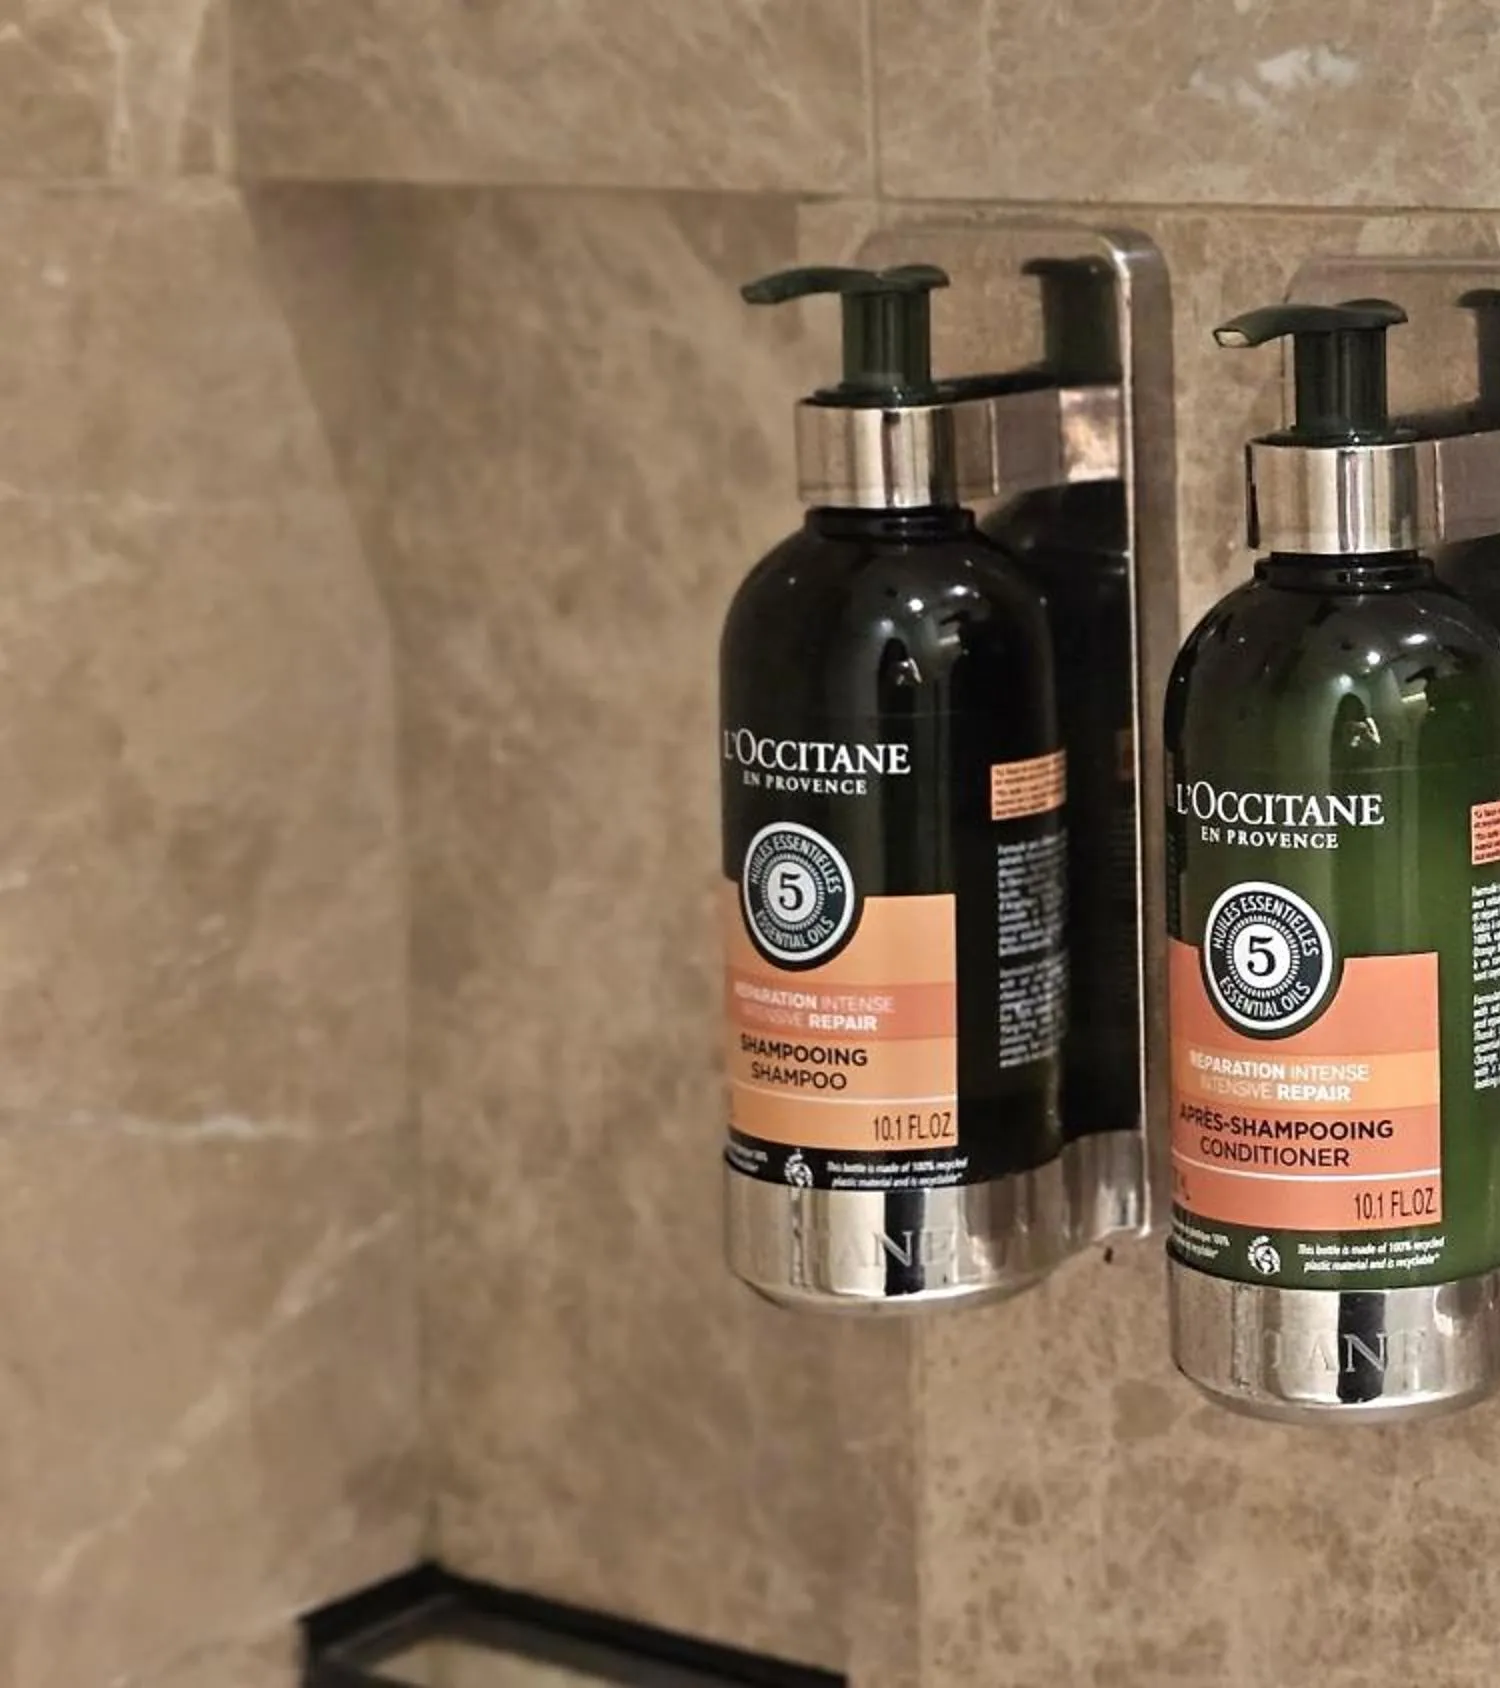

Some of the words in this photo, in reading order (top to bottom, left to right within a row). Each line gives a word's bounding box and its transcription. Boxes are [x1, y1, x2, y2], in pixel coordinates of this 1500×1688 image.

[725, 728, 911, 775] L'OCCITANE
[743, 771, 760, 786] EN
[764, 775, 867, 795] PROVENCE
[1177, 781, 1385, 827] L'OCCITANE
[1201, 826, 1220, 842] EN
[1227, 831, 1339, 849] PROVENCE
[779, 872, 803, 911] 5
[807, 916, 835, 943] OILS
[1212, 902, 1240, 950] HUILES
[1240, 896, 1319, 957] ESSENTIELLES
[1247, 935, 1276, 977] 5
[821, 995, 896, 1013] INTENSE
[1220, 976, 1282, 1017] ESSENTIAL
[1281, 981, 1311, 1011] OILS
[808, 1013, 877, 1031] REPAIR
[740, 1032, 868, 1067] SHAMPOOING
[751, 1061, 847, 1090] SHAMPOO
[1290, 1064, 1370, 1081] INTENSE
[1277, 1084, 1352, 1102] REPAIR
[873, 1115, 901, 1141] 10.1
[1179, 1103, 1394, 1140] APRÈS-SHAMPOOING
[1200, 1135, 1350, 1167] CONDITIONER
[1353, 1192, 1383, 1220] 10.1
